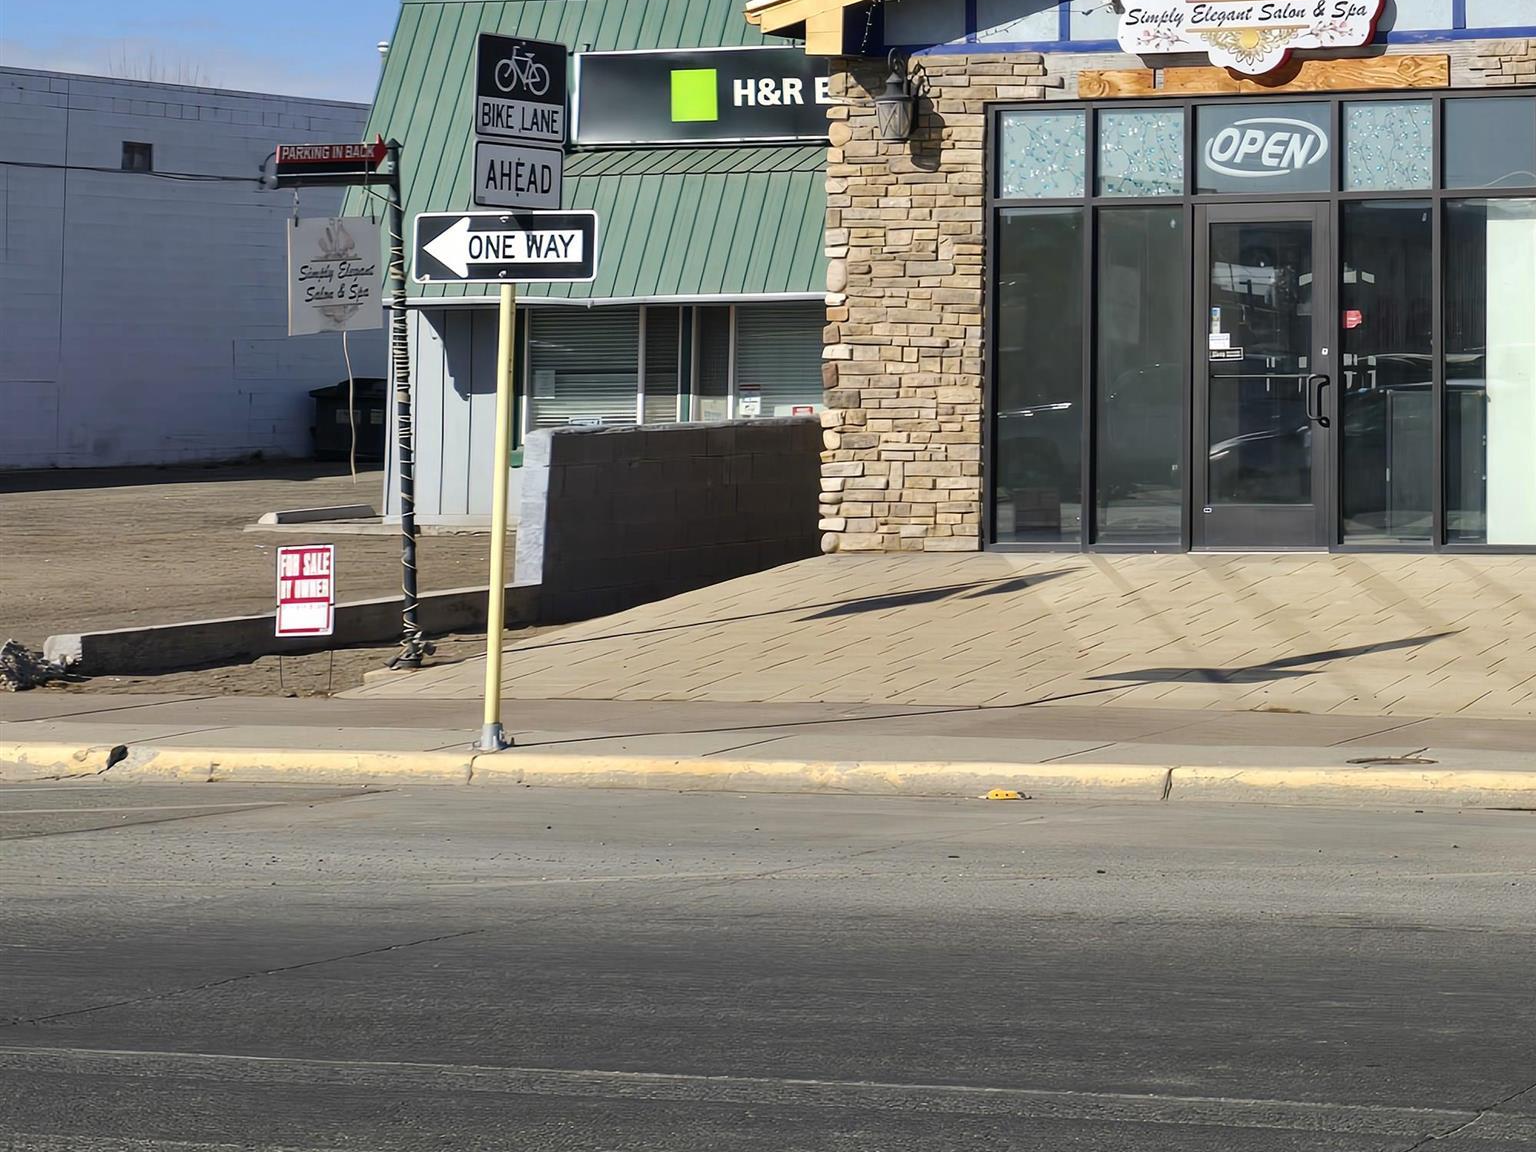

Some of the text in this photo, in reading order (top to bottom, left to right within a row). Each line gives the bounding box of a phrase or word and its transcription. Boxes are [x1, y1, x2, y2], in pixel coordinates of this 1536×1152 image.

[1125, 0, 1368, 28] Simply Elegant Salon & Spa
[733, 77, 805, 106] H&R
[481, 102, 559, 135] BIKE LANE
[281, 145, 375, 160] PARKING IN BACK
[1210, 127, 1317, 169] OPEN
[485, 159, 552, 195] AHEAD
[468, 233, 576, 260] ONE WAY
[303, 551, 331, 576] SALE
